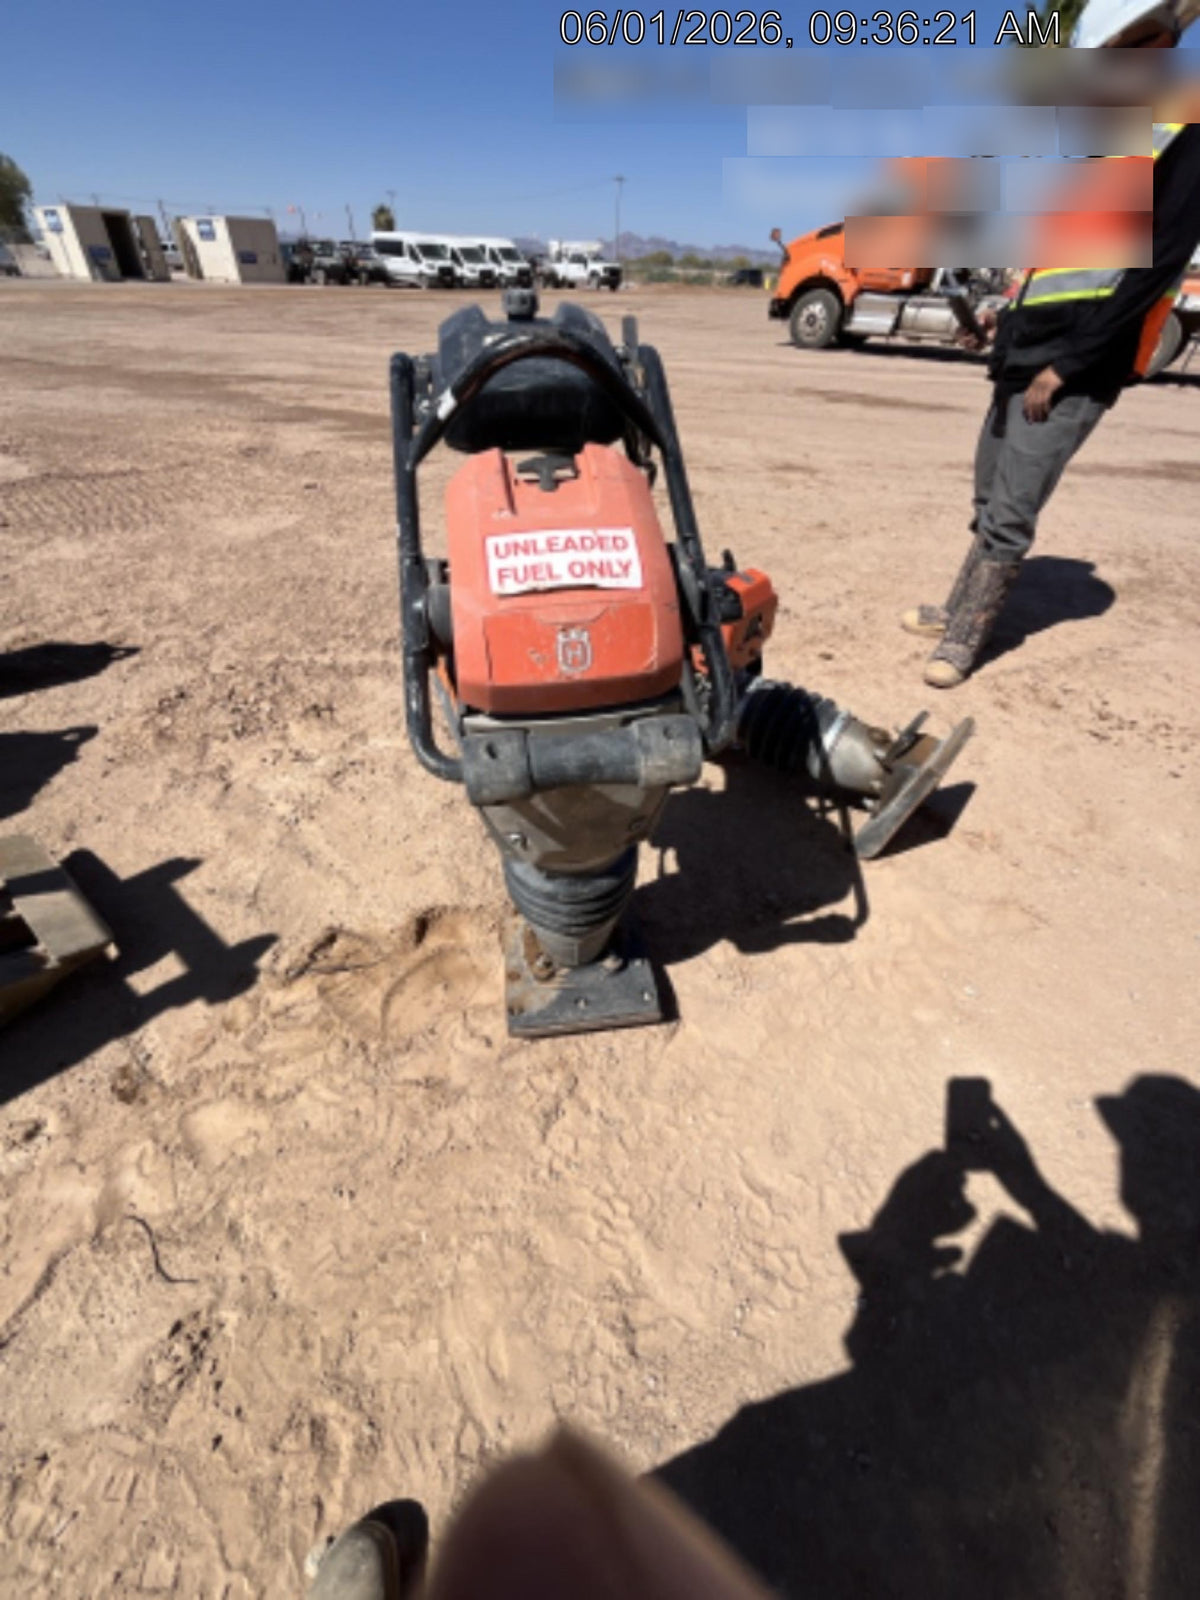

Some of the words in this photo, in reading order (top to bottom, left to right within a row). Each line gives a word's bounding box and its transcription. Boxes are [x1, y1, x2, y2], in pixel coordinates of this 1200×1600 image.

[494, 535, 629, 559] UNLEADED
[497, 562, 561, 587] FUEL
[568, 558, 632, 579] ONLY
